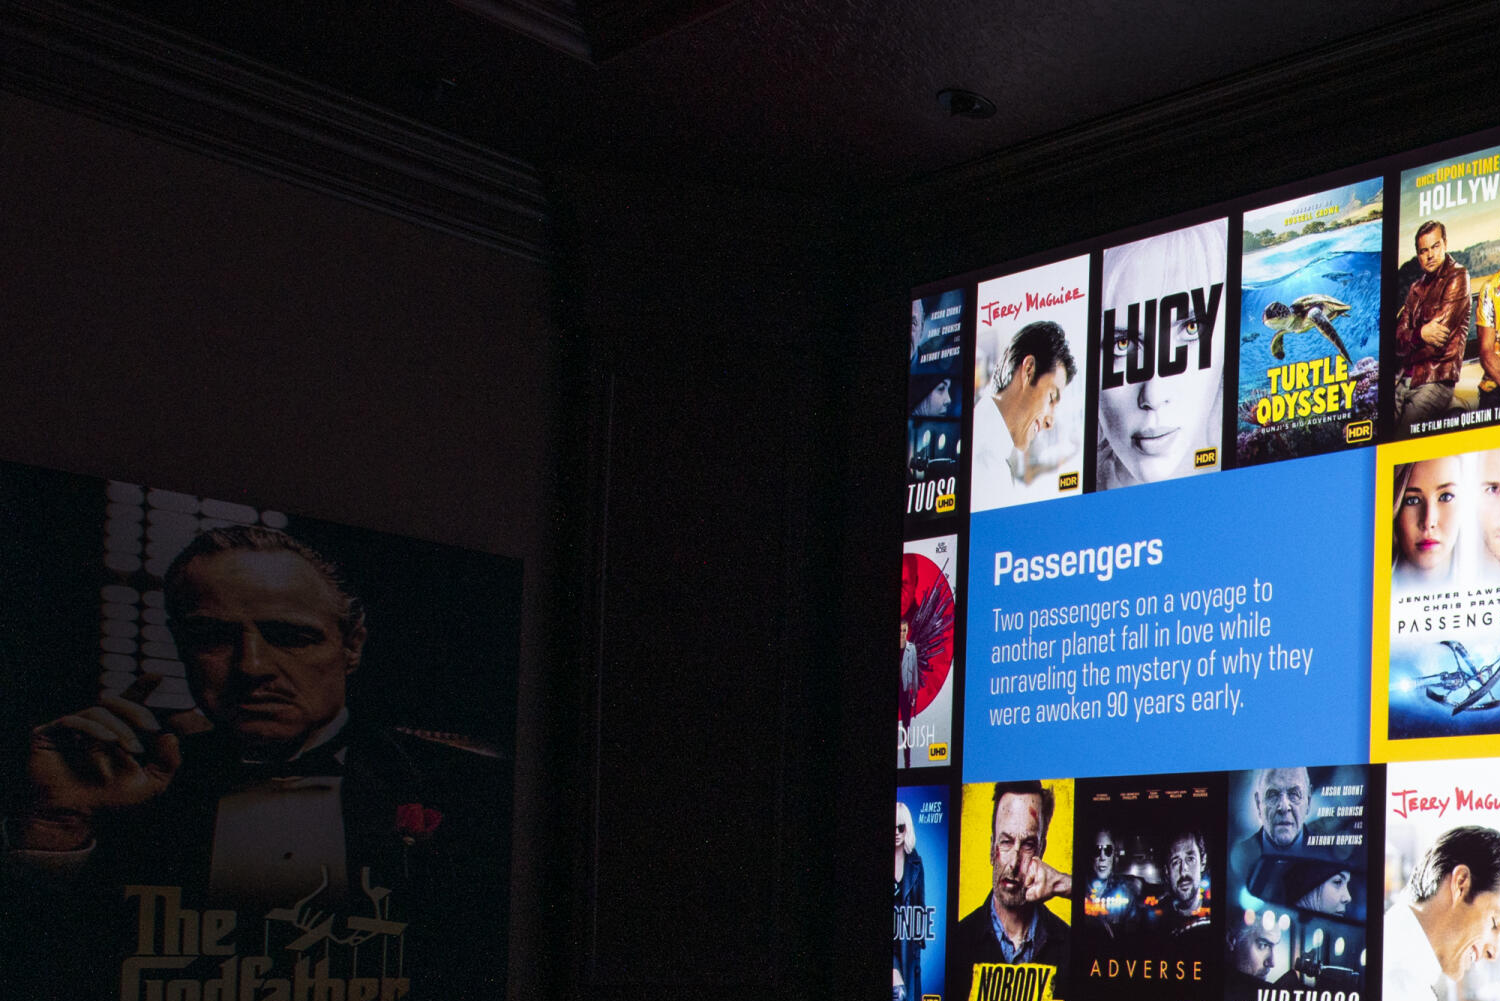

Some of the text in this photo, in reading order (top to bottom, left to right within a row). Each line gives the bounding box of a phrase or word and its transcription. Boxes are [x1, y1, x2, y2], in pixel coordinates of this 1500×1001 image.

[1416, 154, 1500, 188] ONCE UPON A TIME
[1101, 282, 1224, 391] LUCY
[1267, 354, 1349, 395] TURTLE
[1256, 380, 1357, 426] ODYSSEY
[1348, 424, 1371, 440] HDR
[1410, 408, 1492, 434] THE FILM FROM QUENTIN
[1195, 450, 1217, 466] HDR
[1059, 474, 1078, 490] HDR
[937, 495, 955, 511] UHD
[993, 538, 1163, 586] Passengers
[992, 577, 1273, 635] Two passengers on a voyage to
[1398, 591, 1460, 605] JENNIFER
[1423, 602, 1462, 613] CHRIS
[991, 610, 1271, 664] another planet fall in love while
[989, 642, 1314, 697] unraveling the mystery of why they
[989, 682, 1245, 727] were awoken 90 years early.
[929, 746, 947, 758] UHD
[920, 801, 942, 813] JAMES
[124, 884, 238, 956] The
[1090, 959, 1203, 981] ADVERSE
